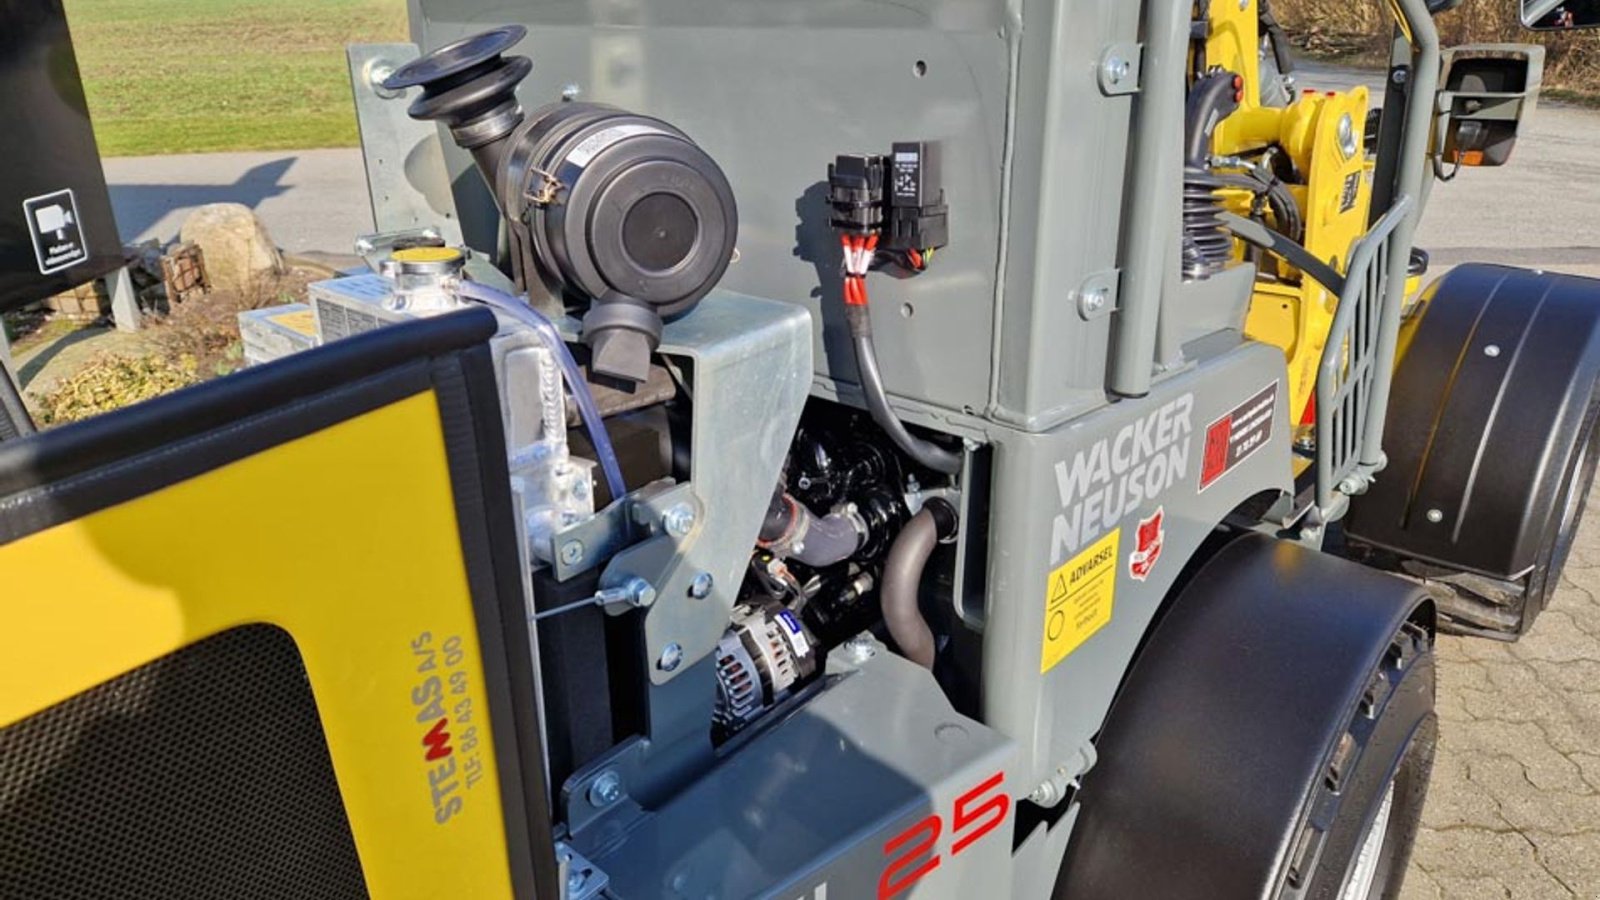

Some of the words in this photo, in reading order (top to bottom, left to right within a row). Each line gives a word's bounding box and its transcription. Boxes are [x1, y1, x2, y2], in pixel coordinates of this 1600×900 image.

[1050, 437, 1192, 565] NEUSON
[1055, 393, 1193, 507] WACKER
[1069, 545, 1113, 585] ADVARSEL
[412, 631, 437, 672] A/S
[443, 636, 464, 666] 00
[412, 676, 462, 824] STEMAS
[877, 772, 1009, 900] 25
